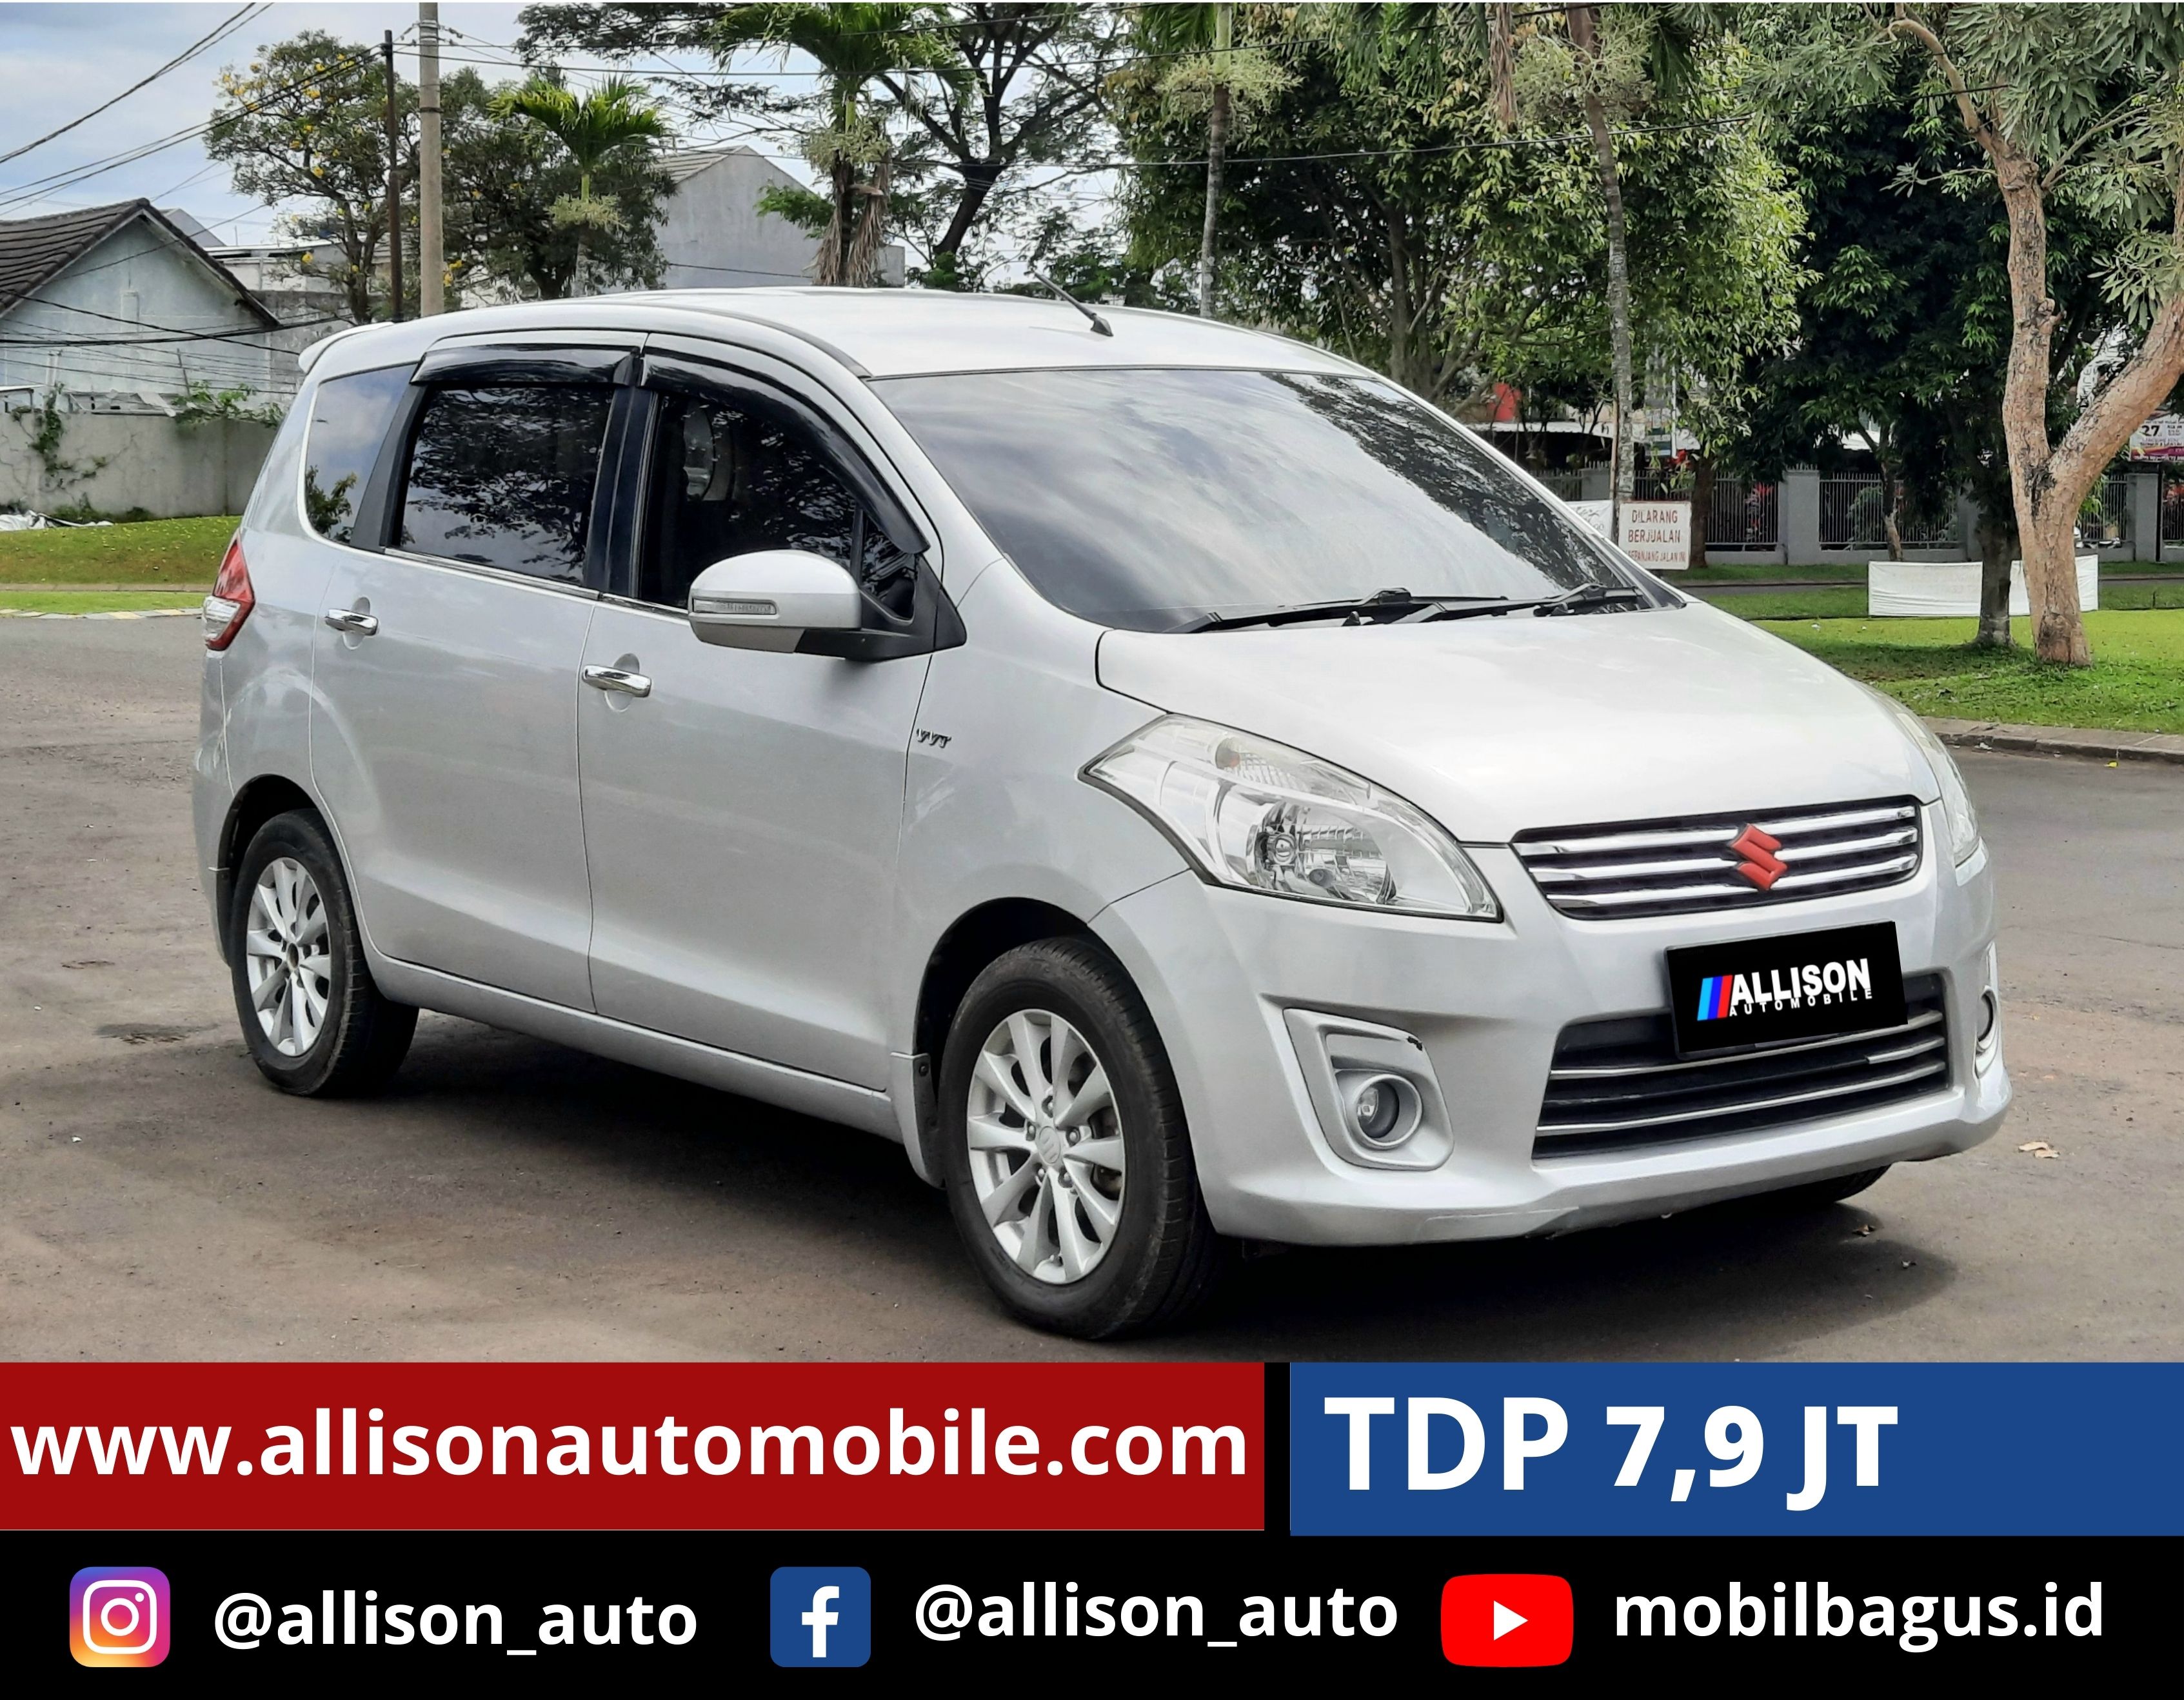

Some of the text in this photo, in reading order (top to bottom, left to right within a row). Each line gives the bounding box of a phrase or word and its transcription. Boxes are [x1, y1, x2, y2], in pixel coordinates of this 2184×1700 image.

[2141, 425, 2160, 437] 27
[1632, 509, 1678, 523] DILARANG
[1628, 529, 1681, 543] BERJUALAN
